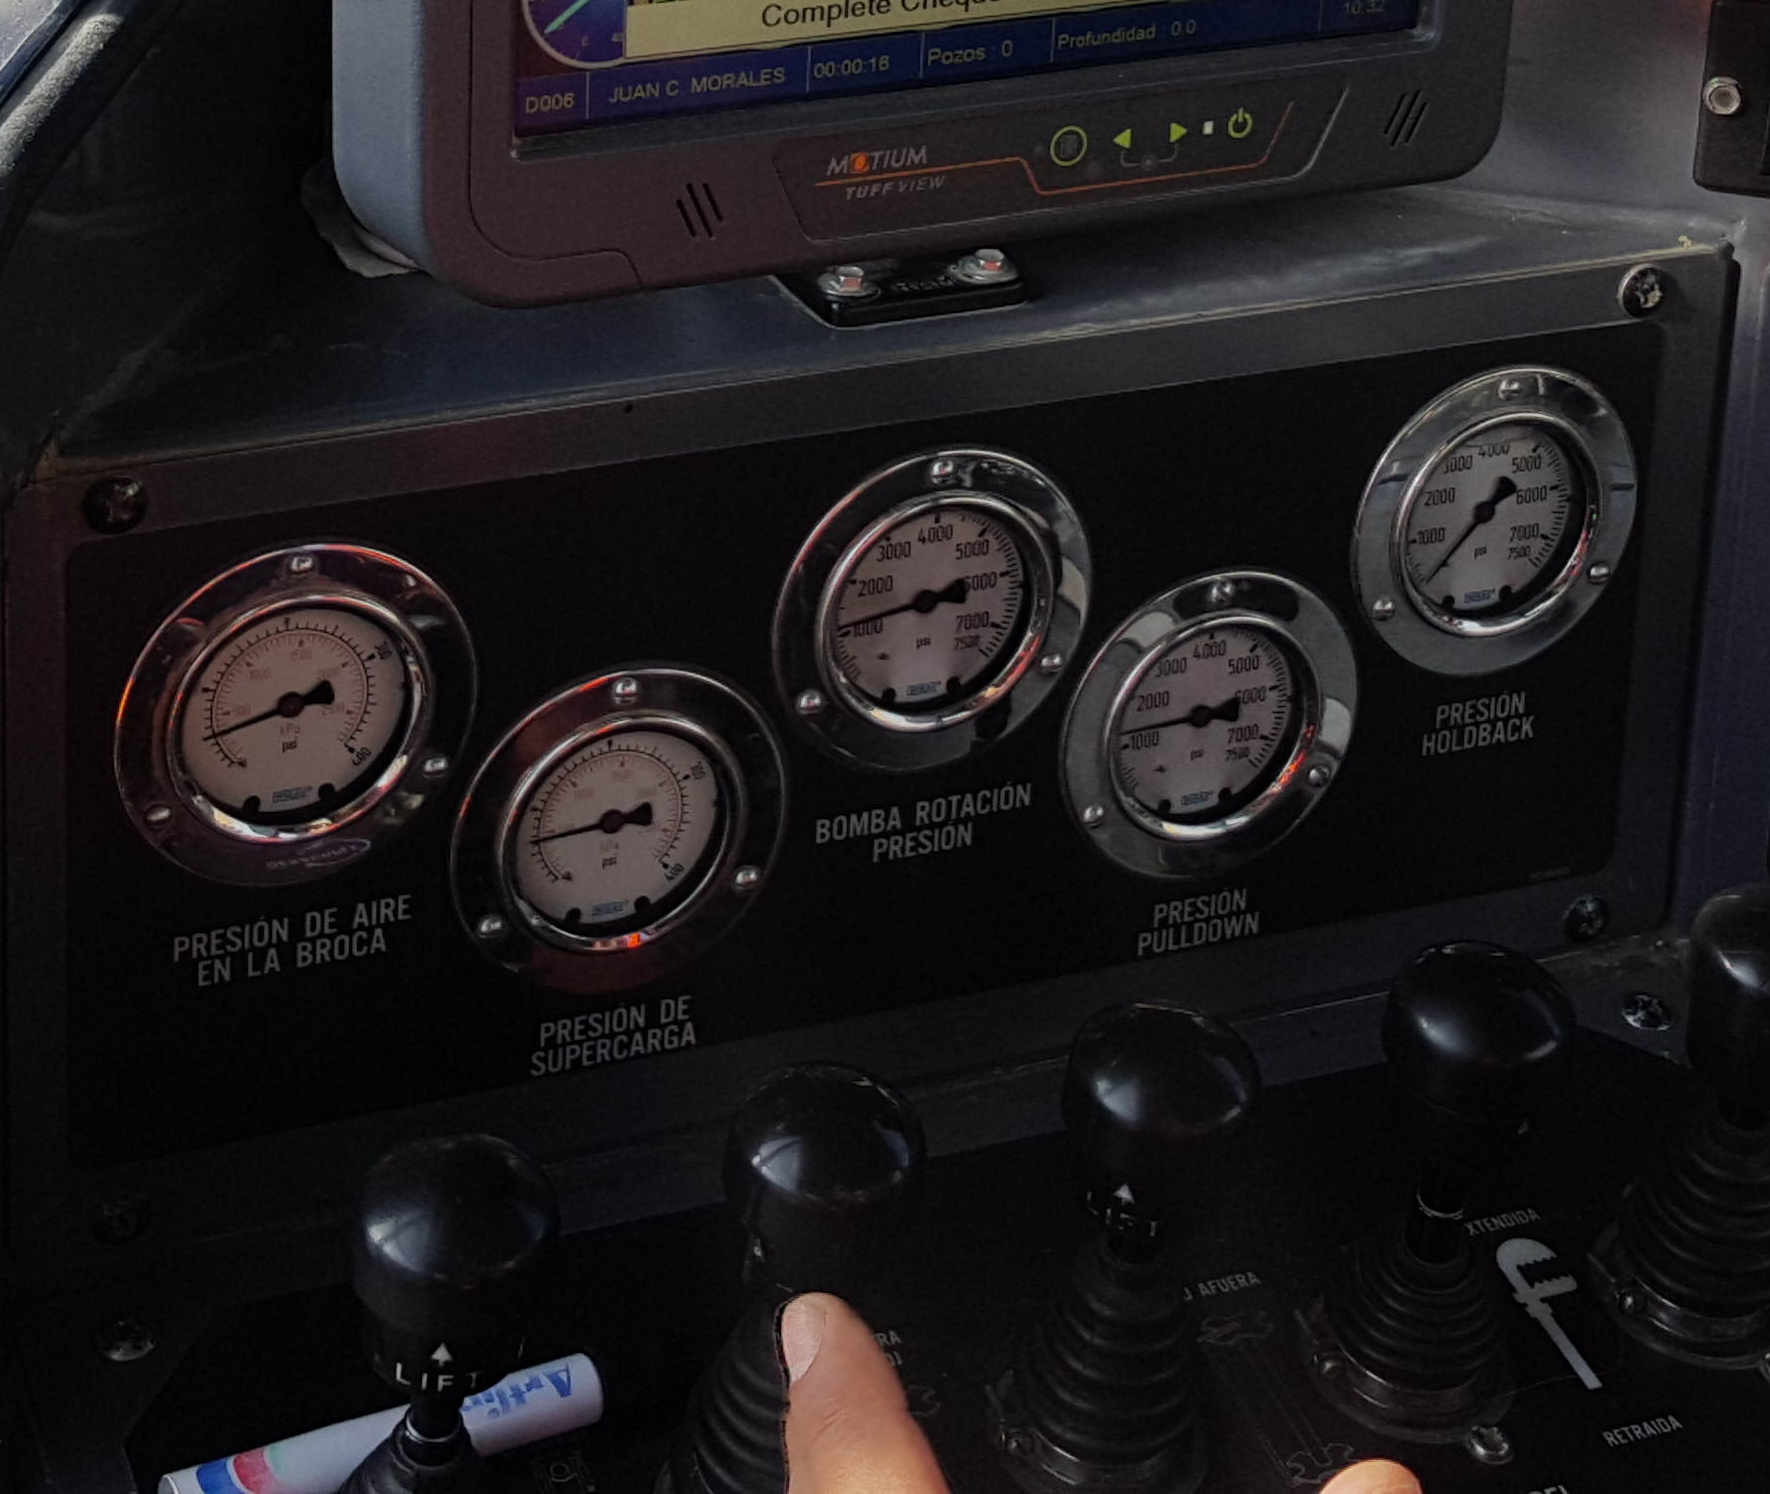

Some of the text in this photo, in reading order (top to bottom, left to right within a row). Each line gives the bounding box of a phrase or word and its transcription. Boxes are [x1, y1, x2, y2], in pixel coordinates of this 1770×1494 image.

[1057, 23, 1156, 50] Profundidad
[928, 45, 986, 67] Pozos
[609, 82, 660, 103] JUAN
[690, 67, 786, 95] MORALES
[1511, 455, 1543, 474] 5000
[1424, 487, 1456, 508] 2000
[1516, 485, 1548, 505] 6000
[917, 523, 954, 544] 4000
[1510, 523, 1540, 543] 7000
[876, 541, 912, 562] 3000
[955, 538, 990, 560] 5000
[858, 574, 894, 597] 2000
[851, 618, 883, 637] 1000
[956, 611, 990, 633] 7000
[1192, 639, 1227, 660] 4000
[1154, 657, 1188, 678] 3000
[1228, 655, 1260, 675] 5000
[1136, 691, 1170, 712] 2000
[1435, 690, 1526, 729] PRESIÓN
[1130, 732, 1160, 750] 1000
[1227, 725, 1260, 744] 7000
[1421, 715, 1535, 756] HOLDBACK
[815, 782, 1031, 844] BOMBA ROTACIÓN
[872, 822, 973, 863] PRESIÓN
[1153, 887, 1248, 928] PRESIÓN
[174, 894, 412, 963] PRESIÓN DE AIRE
[1137, 912, 1260, 956] PULLDOWN
[197, 928, 388, 987] EN LA BROCA
[660, 995, 691, 1024] DE
[531, 1022, 697, 1077] SUPERCARGA
[1464, 1206, 1542, 1236] XTENDIDA
[1197, 1271, 1262, 1298] AFUERA
[1602, 1413, 1684, 1447] RETRAIDA
